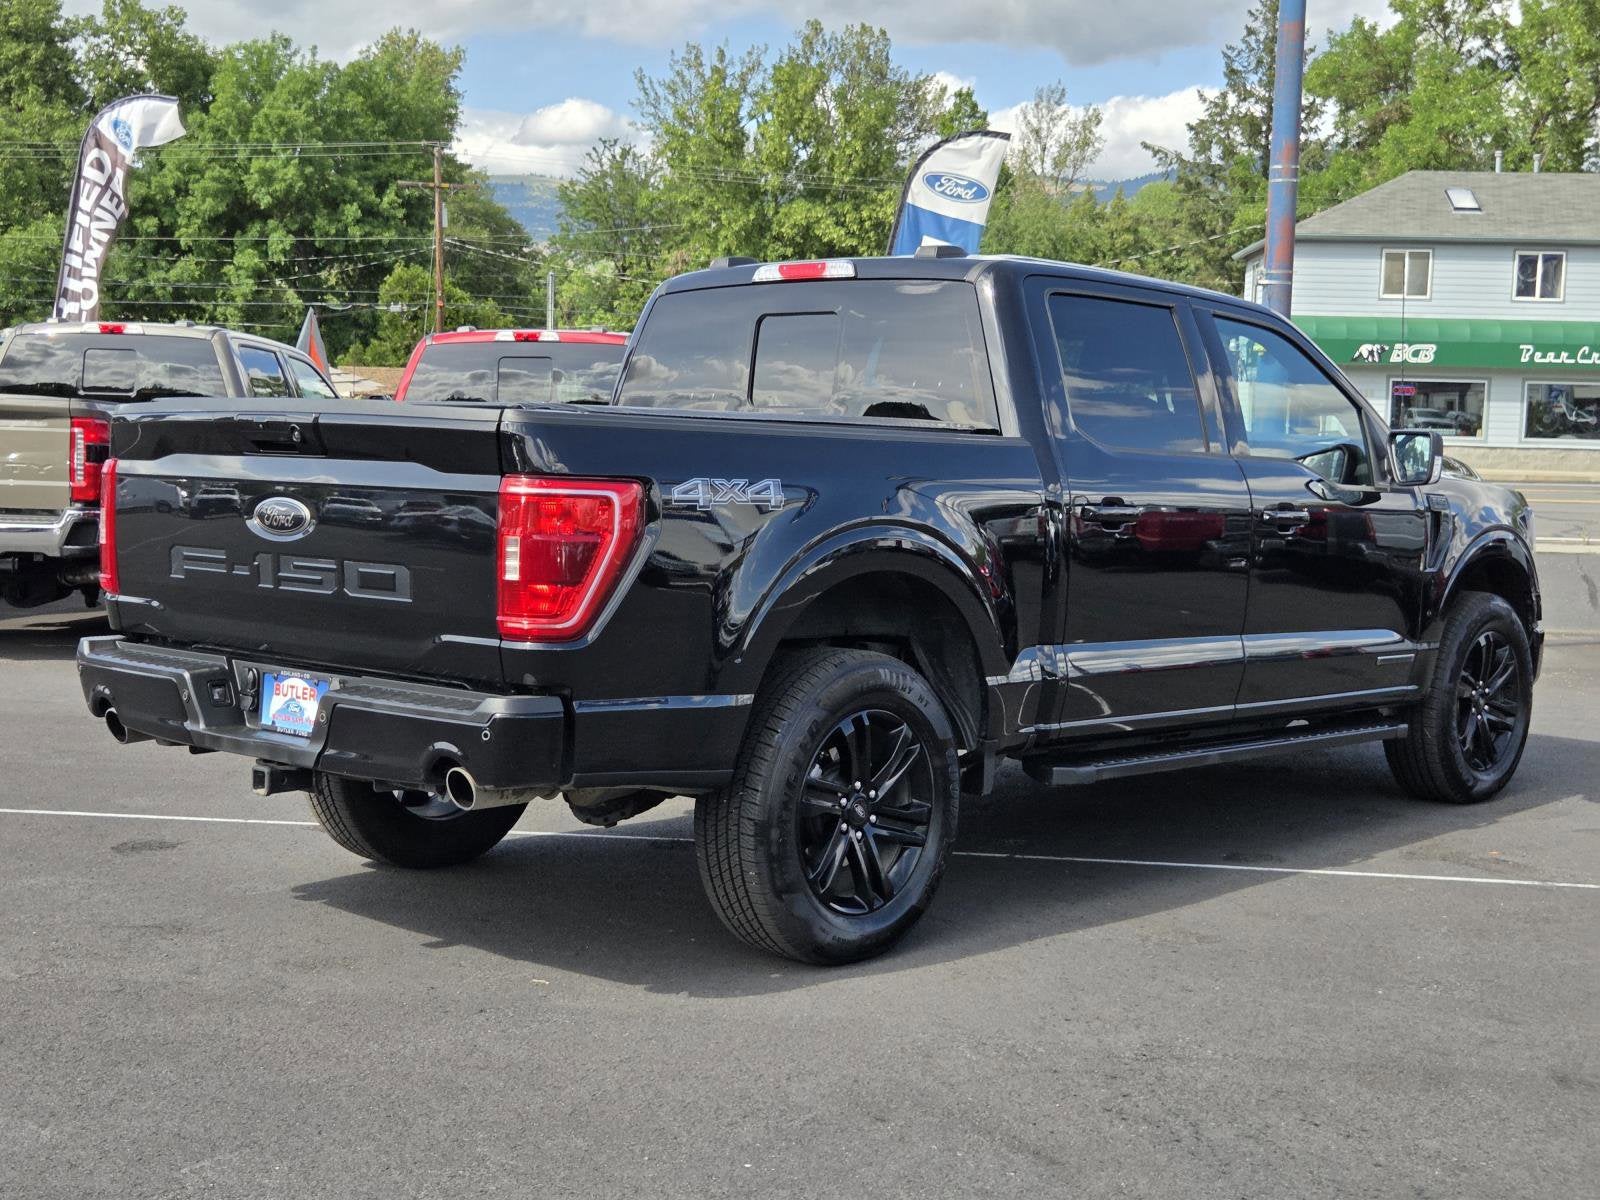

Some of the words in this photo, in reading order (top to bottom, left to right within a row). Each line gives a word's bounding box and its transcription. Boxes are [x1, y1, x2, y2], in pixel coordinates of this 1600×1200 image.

[935, 176, 977, 200] Ford
[1389, 343, 1437, 364] BCB
[1519, 344, 1576, 364] Bear
[263, 506, 296, 529] Ford
[169, 544, 413, 603] F-150
[273, 682, 317, 702] BUTLER
